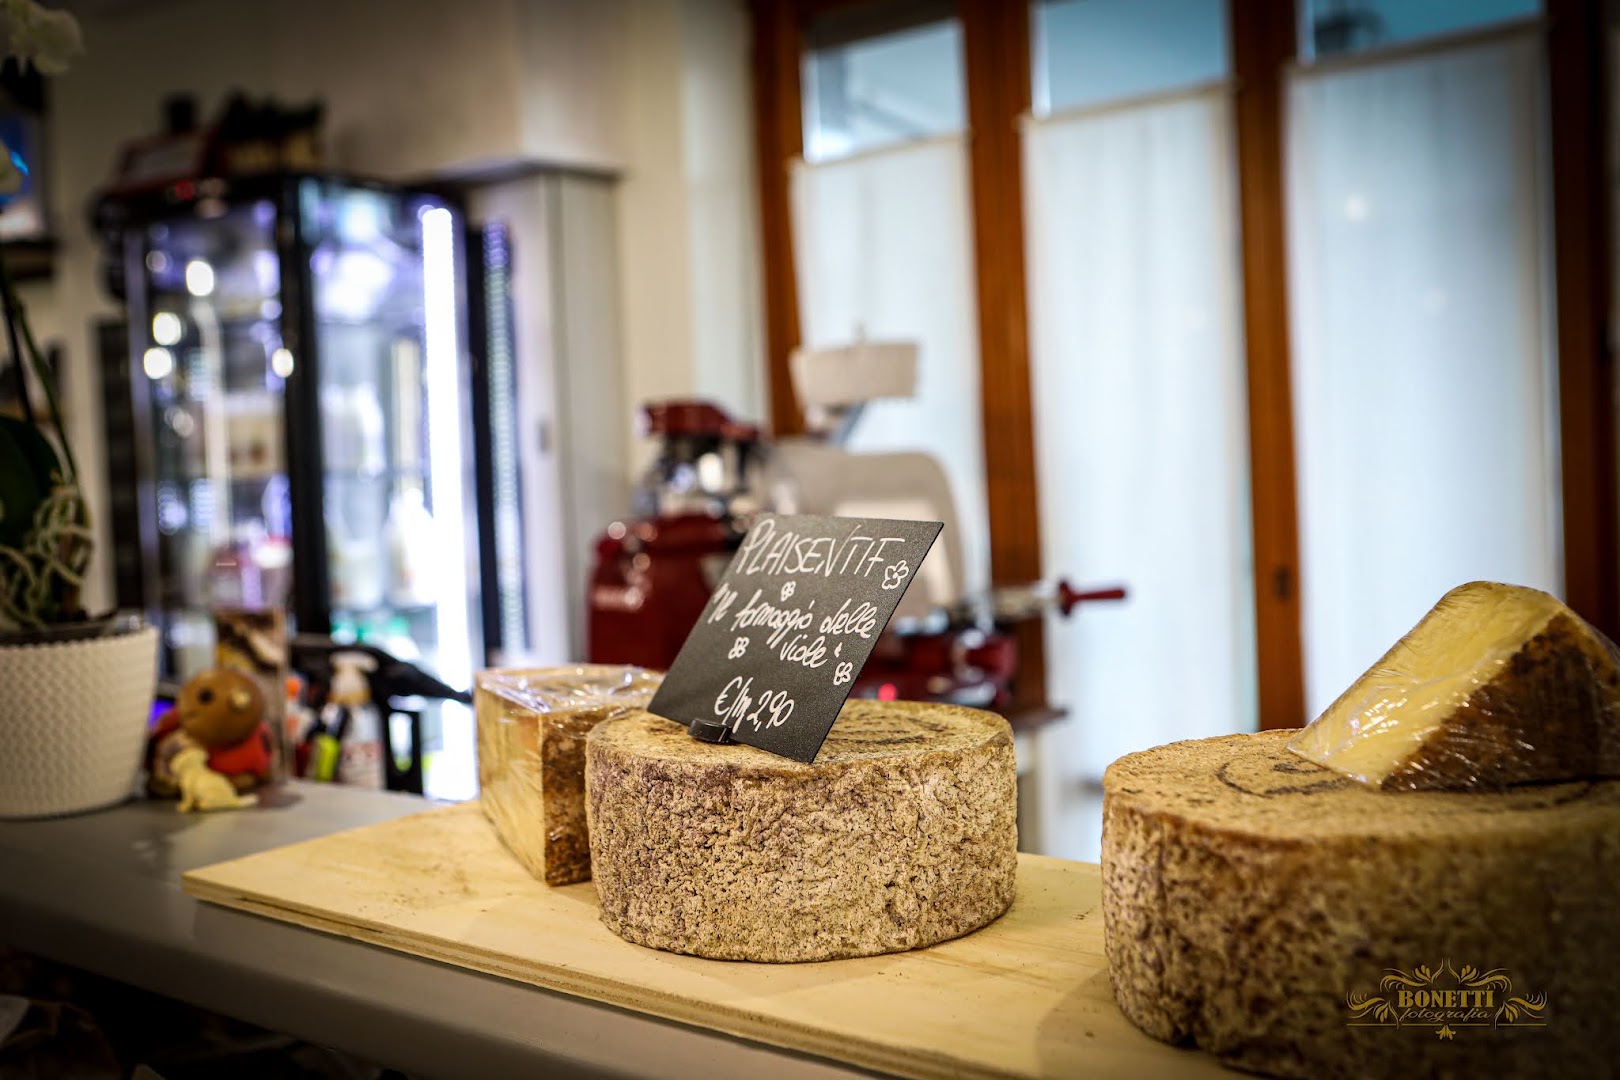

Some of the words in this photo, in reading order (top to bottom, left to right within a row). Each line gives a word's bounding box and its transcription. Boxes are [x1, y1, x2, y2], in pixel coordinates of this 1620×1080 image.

[735, 518, 906, 577] PLAISENTIF
[819, 598, 878, 639] delle
[746, 689, 795, 732] 2,90
